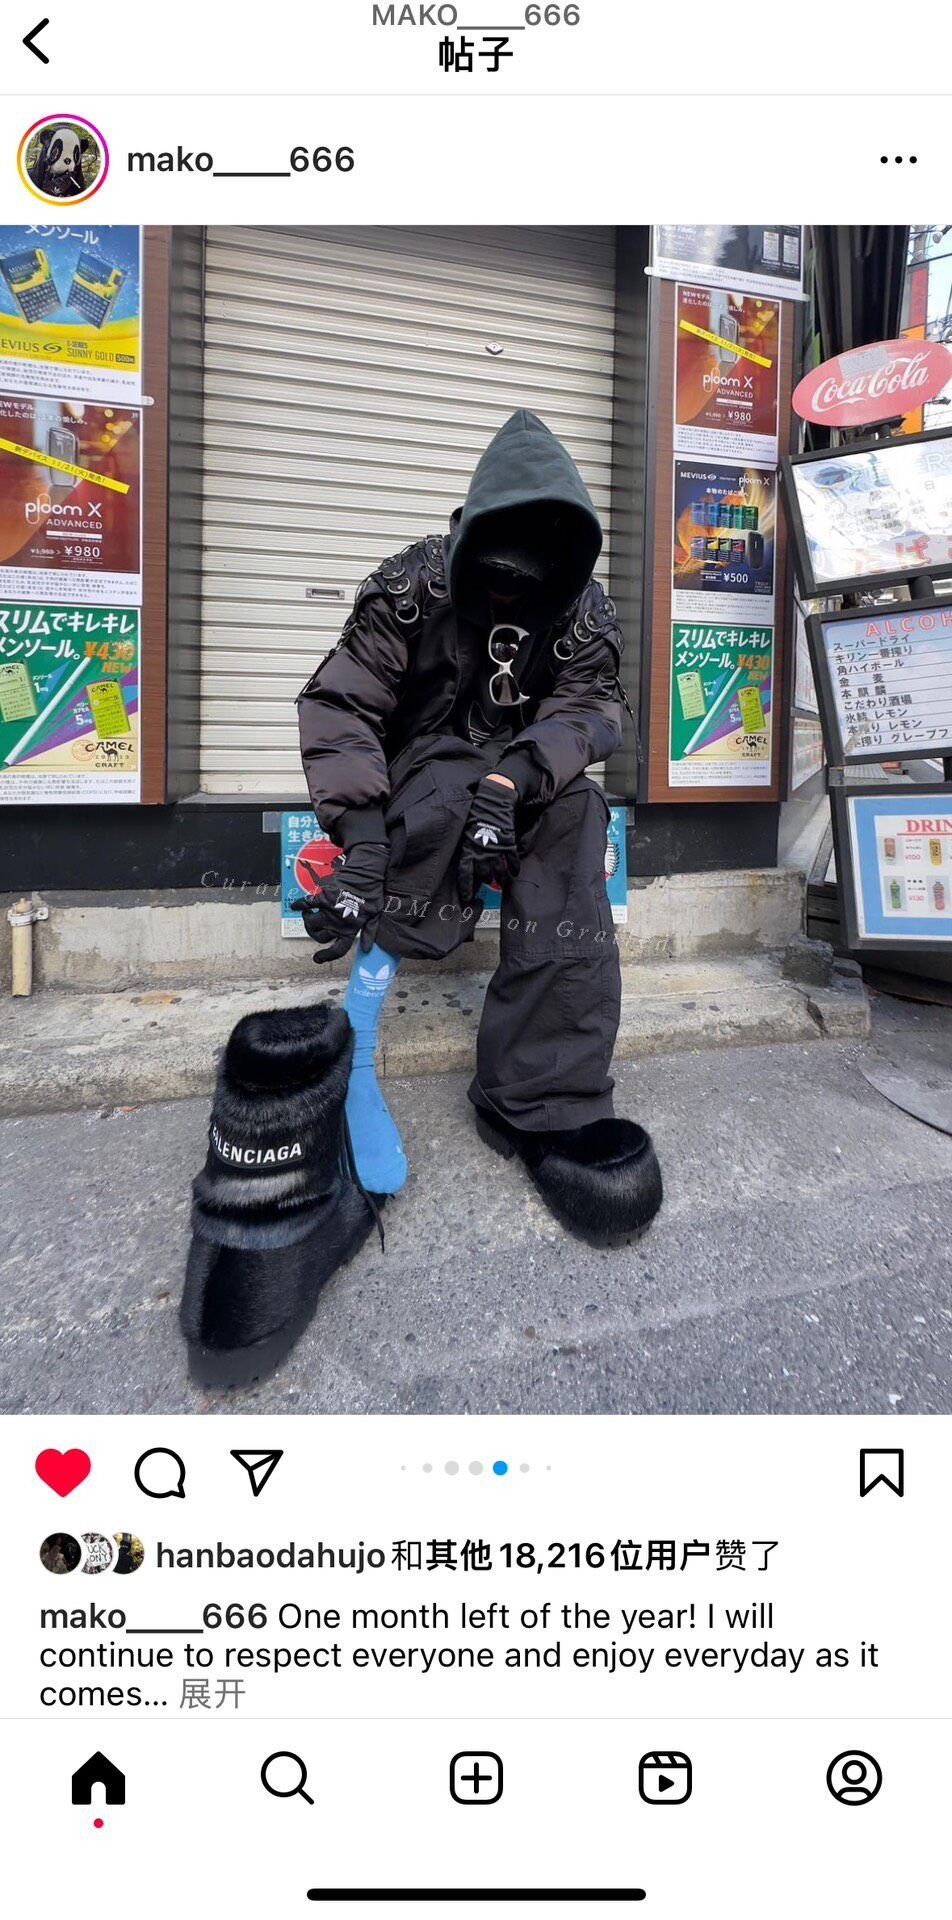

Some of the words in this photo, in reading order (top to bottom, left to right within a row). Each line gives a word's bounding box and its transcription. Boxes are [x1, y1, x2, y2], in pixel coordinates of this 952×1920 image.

[439, 36, 513, 72] 帖子
[67, 347, 92, 359] SUNNY
[95, 350, 114, 362] GOLD
[703, 367, 740, 393] ploom
[743, 375, 753, 389] X
[811, 350, 932, 412] Coca-Cola
[716, 388, 754, 399] ADVANCED
[727, 410, 751, 422] ¥980
[680, 471, 707, 481] MEVIUS
[763, 477, 770, 486] X
[25, 493, 82, 525] ploom
[87, 502, 102, 518] X
[46, 518, 103, 530] ADVANCED
[64, 544, 101, 558] ¥980
[723, 572, 749, 584] ¥500
[0, 610, 135, 635] スリムでキレキレ
[675, 628, 770, 650] スリムでキレキレ
[833, 634, 910, 651] スーパードライ
[101, 661, 134, 674] NEW
[675, 651, 735, 669] メンソール。
[837, 659, 905, 676] 角ハイボール
[844, 694, 913, 711] こだわり酒場
[889, 719, 922, 730] レモン
[85, 741, 135, 753] CAMEL
[736, 735, 768, 745] CAMEL
[279, 1602, 341, 1630] One
[352, 1602, 449, 1630] month
[461, 1602, 510, 1630] left
[520, 1602, 552, 1630] of
[560, 1602, 611, 1630] the
[620, 1603, 697, 1636] year!
[708, 1603, 714, 1629] I
[724, 1602, 773, 1630] will
[39, 1640, 174, 1669] continue
[183, 1643, 214, 1669] to
[225, 1643, 342, 1674] respect
[352, 1647, 494, 1674] everyone
[504, 1641, 561, 1669] and
[572, 1640, 655, 1674] enjoy
[664, 1640, 805, 1674] everyday
[815, 1647, 850, 1669] as
[860, 1640, 879, 1669] it
[39, 1684, 168, 1708] comes...
[179, 1678, 246, 1709] 展开
